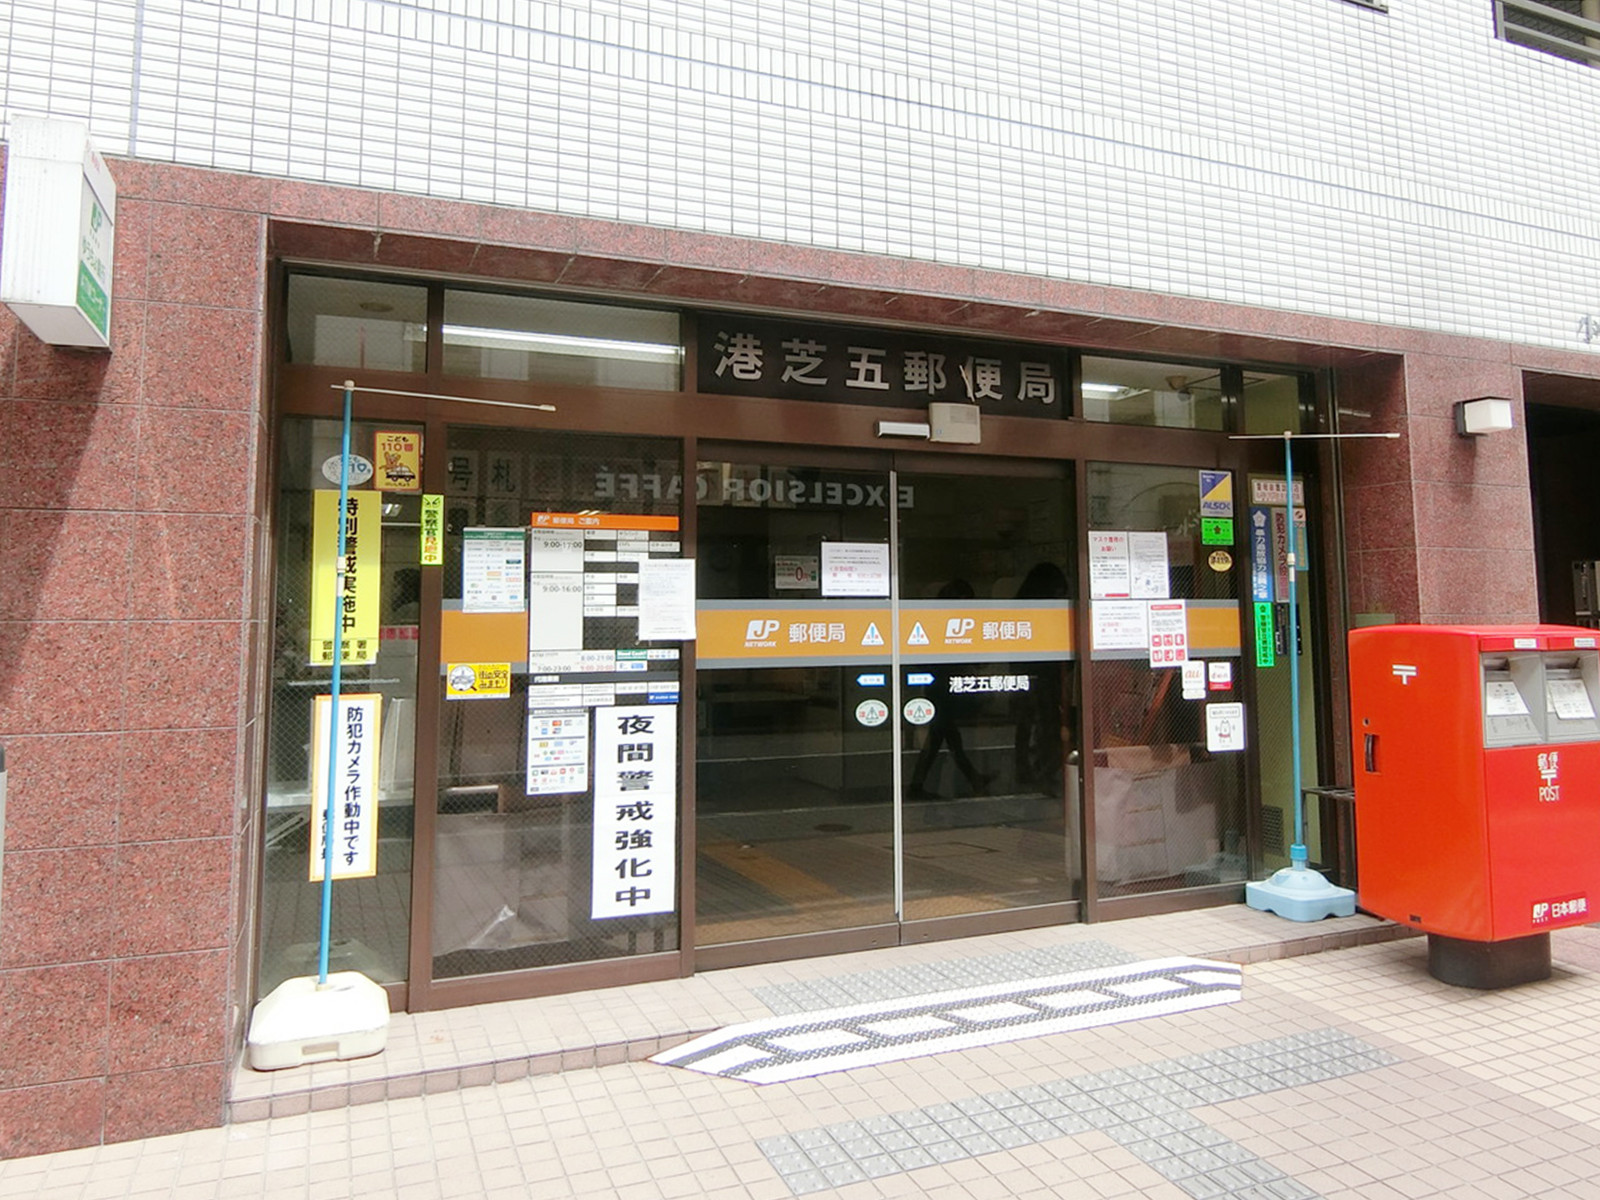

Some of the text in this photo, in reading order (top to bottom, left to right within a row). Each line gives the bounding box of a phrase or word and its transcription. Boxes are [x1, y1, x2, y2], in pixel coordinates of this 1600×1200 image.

[714, 330, 1056, 404] 港芝五郵便局
[1202, 501, 1231, 510] ALSOK
[789, 623, 846, 643] 郵便局
[982, 621, 1032, 640] 郵便局
[948, 674, 1031, 694] 港芝五郵便局
[1537, 752, 1559, 770] 郵便
[343, 706, 364, 866] 防犯カメラ作動中です
[1538, 785, 1560, 802] POST
[614, 714, 655, 907] 夜間警戒強化中
[1551, 898, 1588, 918] 日本郵便
